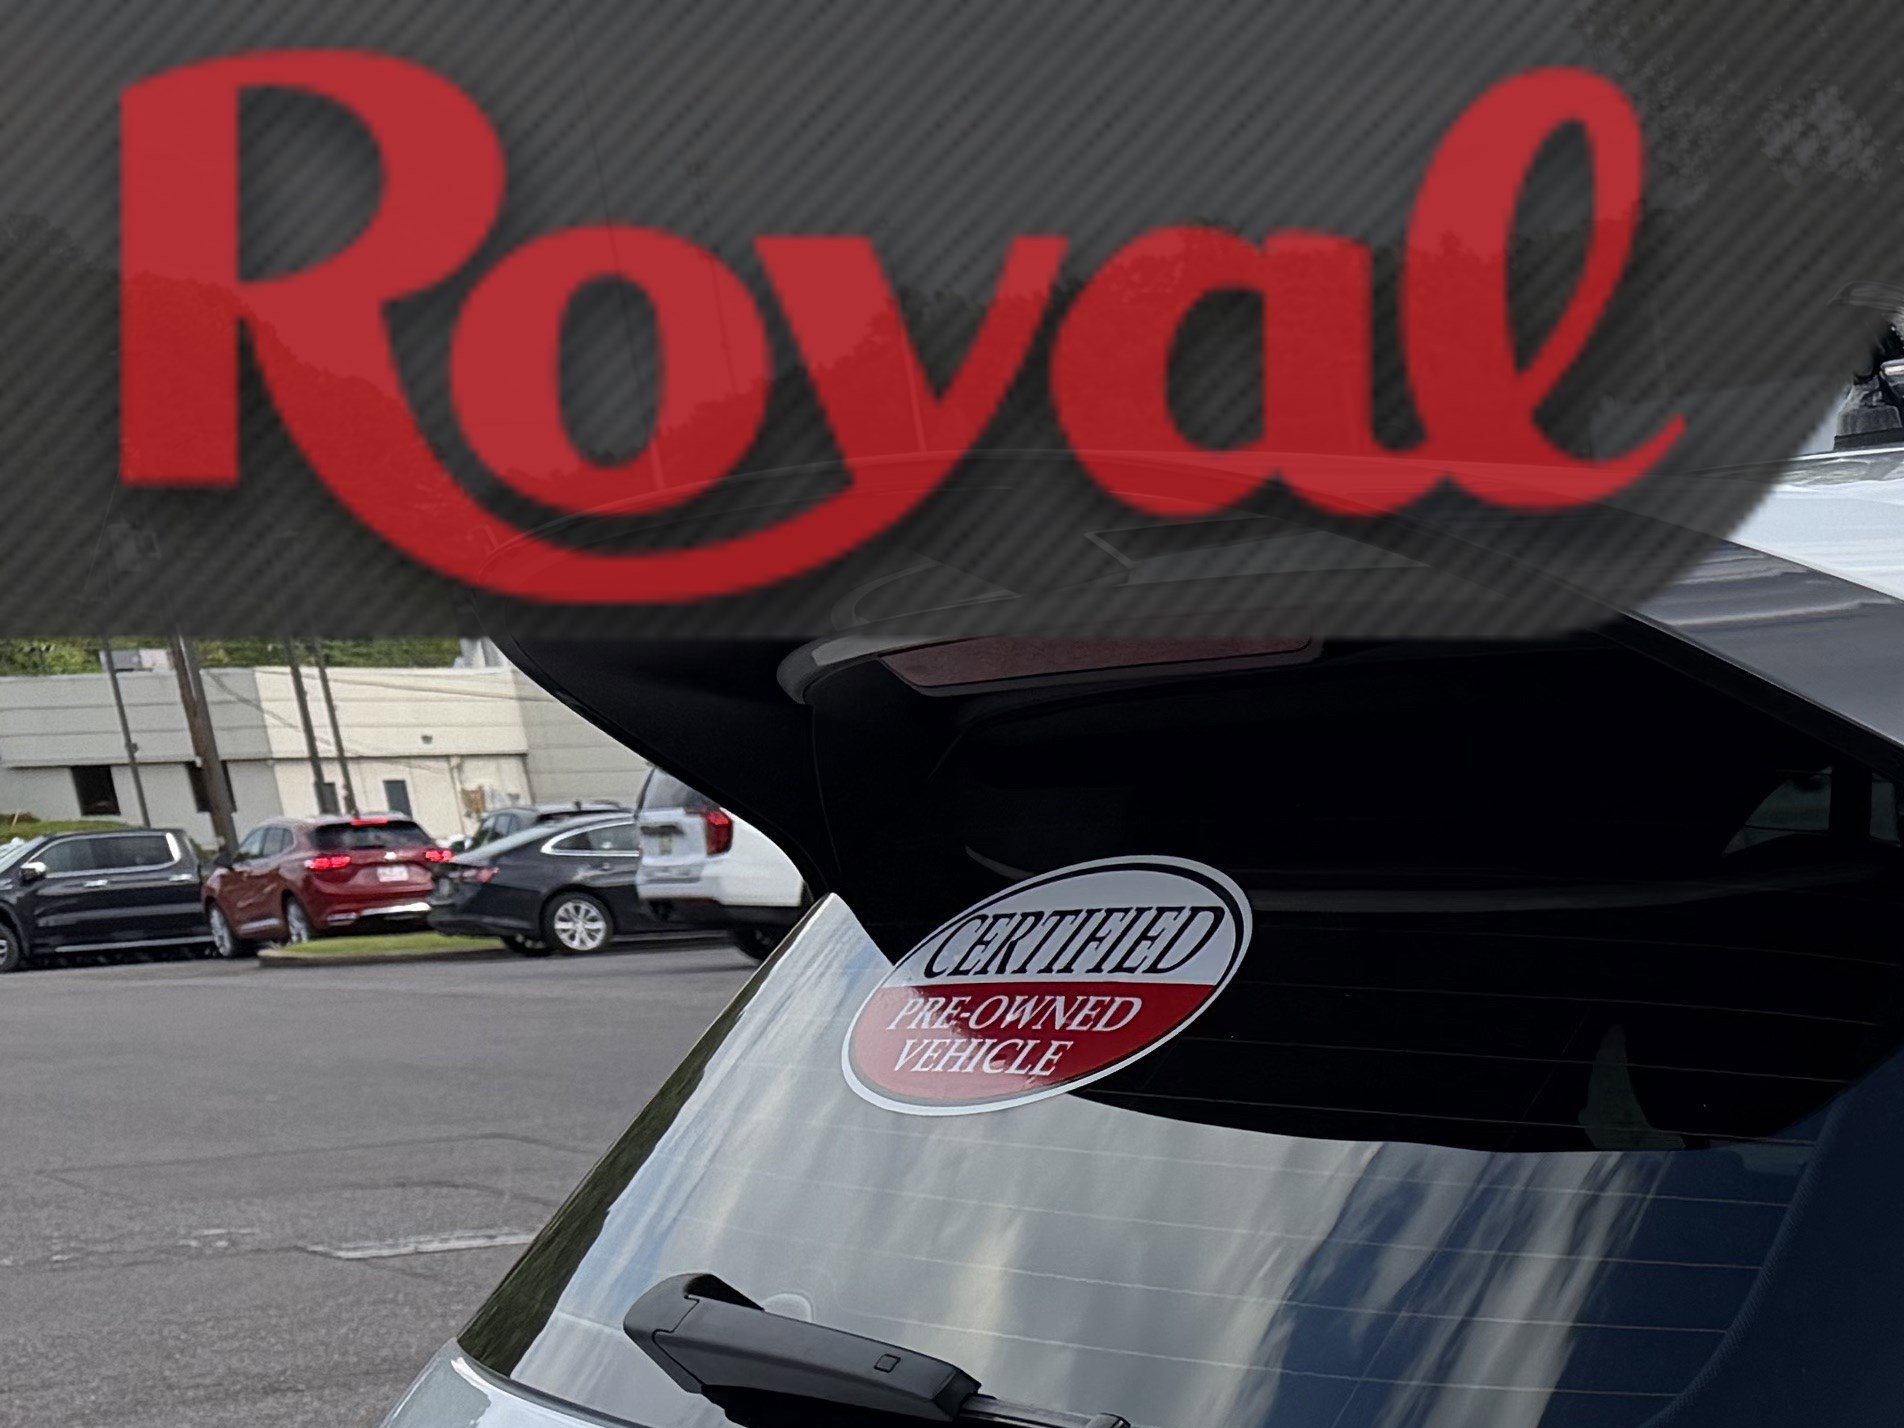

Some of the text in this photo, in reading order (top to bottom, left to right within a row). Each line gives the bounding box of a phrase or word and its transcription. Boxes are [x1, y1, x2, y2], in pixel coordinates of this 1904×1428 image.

[922, 905, 1227, 979] CERTIFIED
[886, 994, 1144, 1032] PRE-OWNED
[891, 1038, 1074, 1077] VEHICLE
